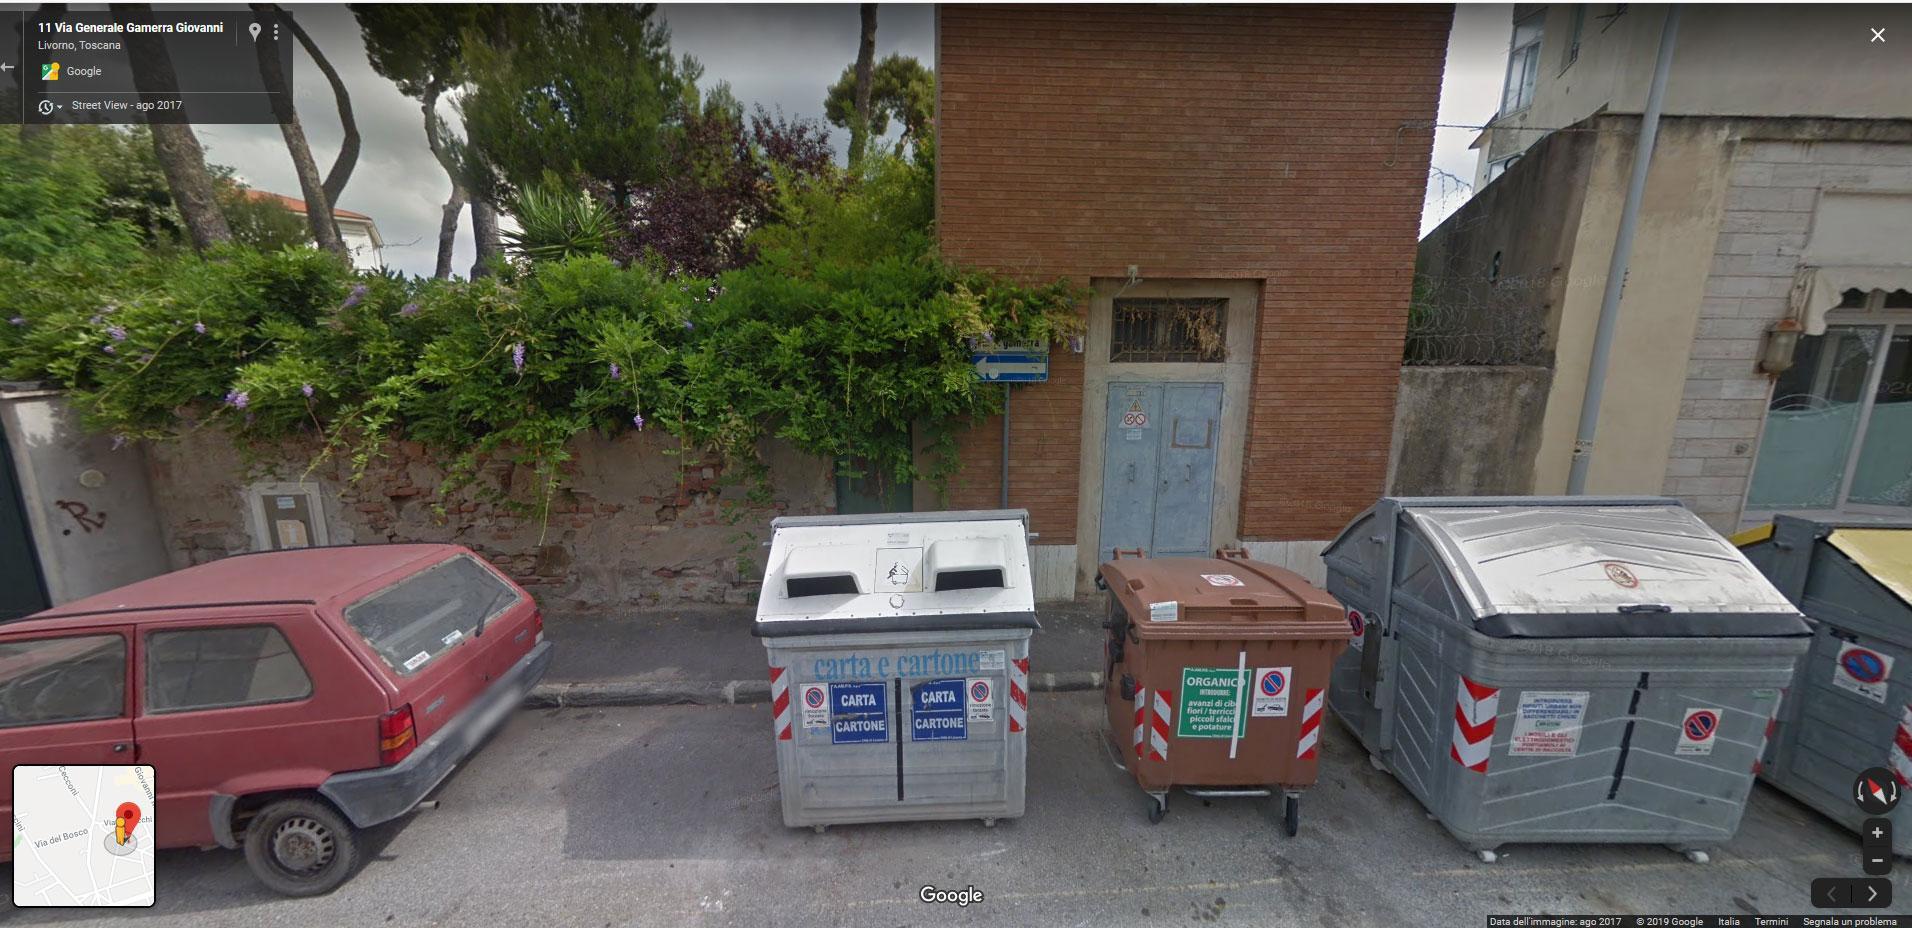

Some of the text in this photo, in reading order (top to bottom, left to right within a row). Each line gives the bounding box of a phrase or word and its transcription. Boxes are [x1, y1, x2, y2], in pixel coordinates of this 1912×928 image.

[815, 653, 871, 680] carta
[878, 656, 890, 678] e
[897, 650, 980, 679] cartone
[841, 694, 876, 706] CARTA
[921, 690, 956, 704] CARTA
[1214, 699, 1223, 707] di
[1187, 707, 1203, 715] fiori
[1208, 707, 1236, 715] terricci
[915, 717, 964, 729] CARTONE
[1190, 715, 1236, 724] piccoli sfalc
[836, 720, 885, 732] CARTONE
[1198, 724, 1232, 732] potature
